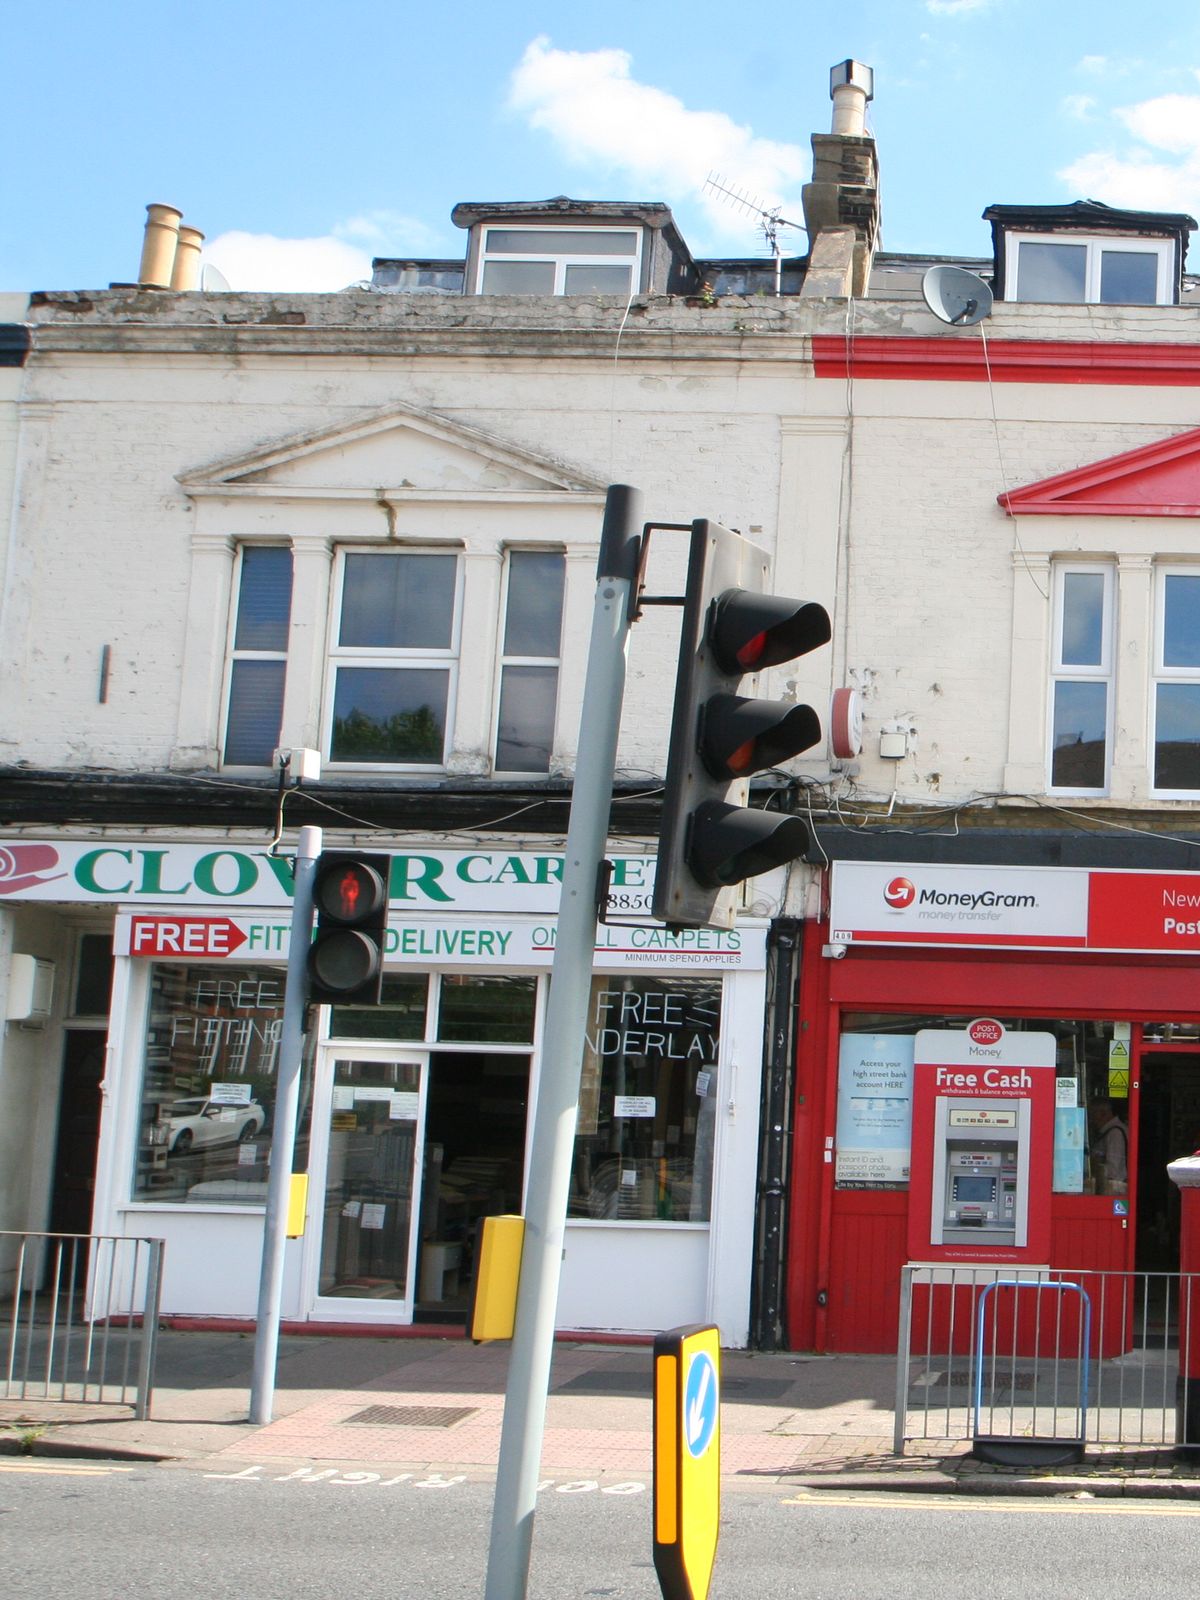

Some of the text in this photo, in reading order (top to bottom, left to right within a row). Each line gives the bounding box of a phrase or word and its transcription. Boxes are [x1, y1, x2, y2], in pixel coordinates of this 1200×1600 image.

[919, 889, 1036, 911] MoneyGram
[1163, 889, 1200, 907] New
[919, 911, 1002, 922] money transfer
[134, 922, 230, 953] FREE
[384, 928, 513, 956] DELIVERY
[631, 929, 742, 950] CARPETS
[835, 931, 852, 940] 409
[625, 953, 742, 964] MINIMUM SPEND APPLIES
[196, 980, 279, 1009] FREE
[596, 991, 688, 1025] FREE
[972, 1031, 998, 1040] OFFICE
[976, 1024, 996, 1032] POST
[585, 1028, 719, 1060] NDERLAY
[969, 1047, 1001, 1058] Money
[853, 1069, 867, 1079] high
[936, 1068, 1032, 1088] Free Cash
